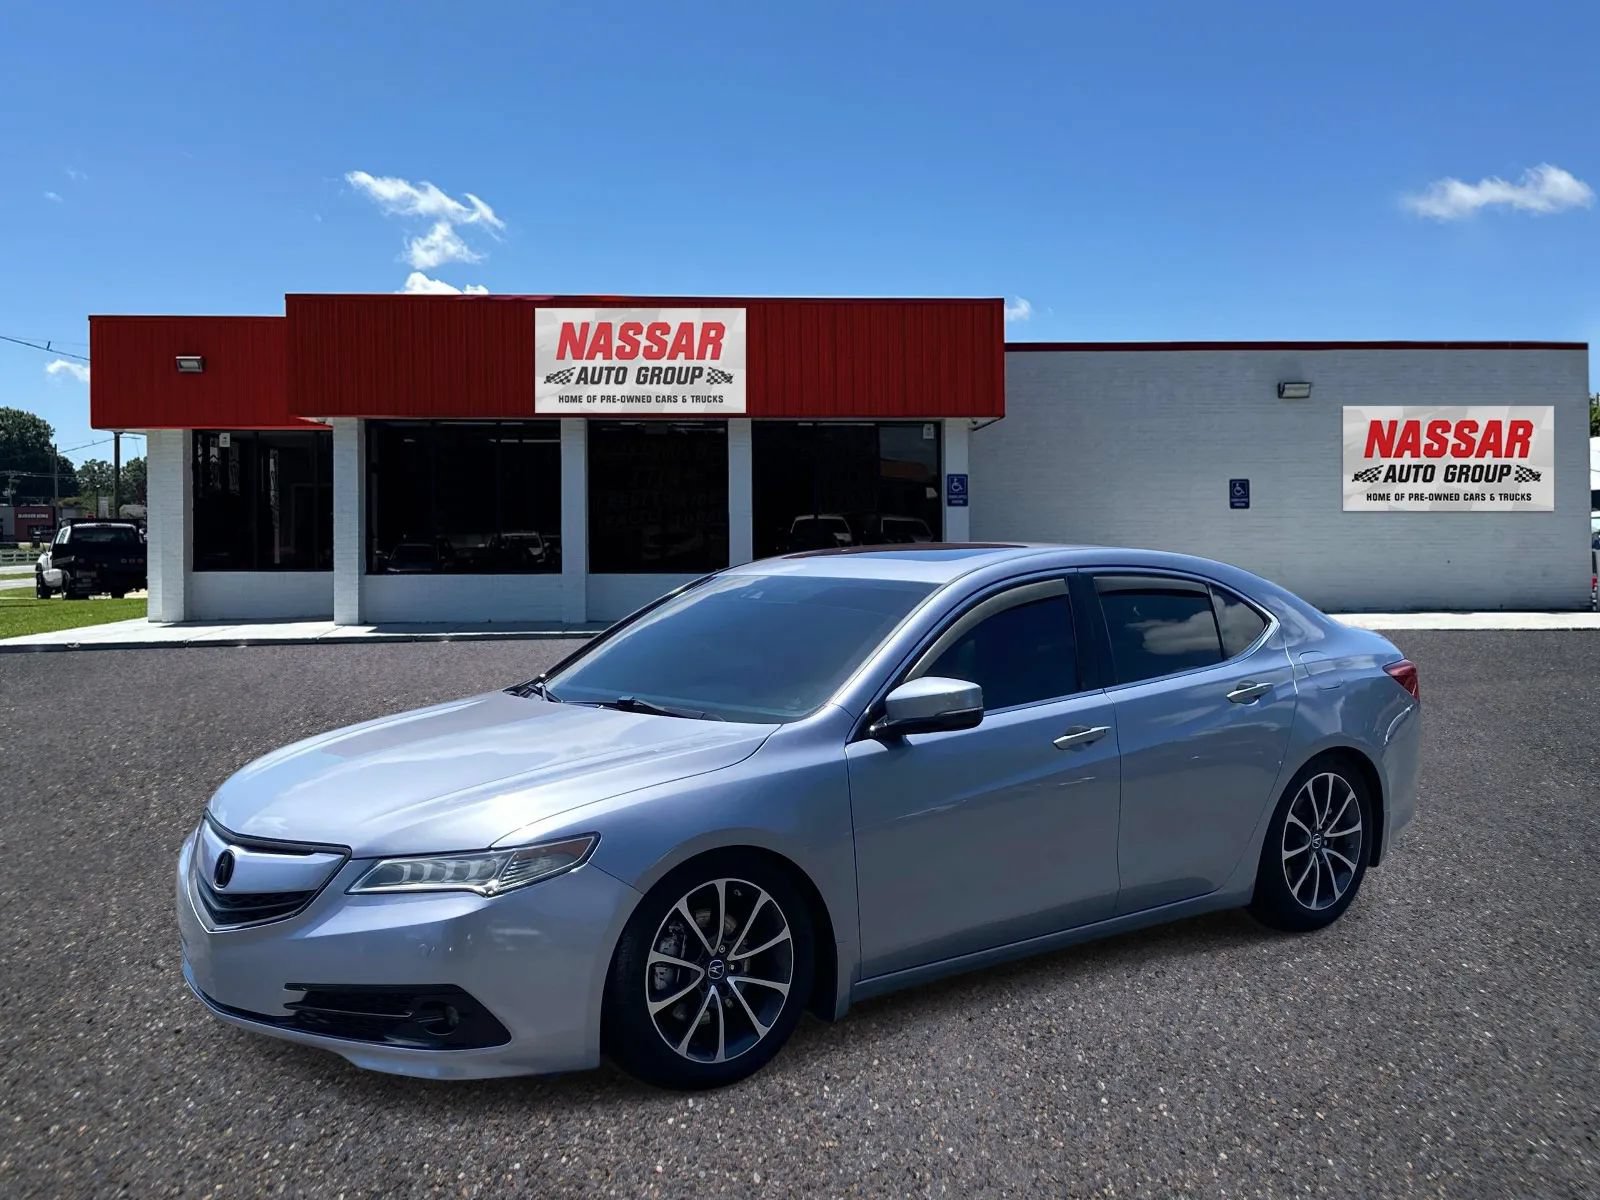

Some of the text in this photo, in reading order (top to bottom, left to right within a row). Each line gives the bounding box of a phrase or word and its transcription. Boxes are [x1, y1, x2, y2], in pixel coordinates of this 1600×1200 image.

[556, 321, 726, 361] NASSAR
[575, 367, 704, 385] AUTO GROUP
[559, 395, 723, 403] HOME OF PRE-OWNED CARS & TRUCKS
[1364, 419, 1534, 459] NASSAR
[1383, 464, 1512, 483] AUTO GROUP
[1367, 493, 1531, 501] HOME OF PRE-OWNED CARS & TRUCKS
